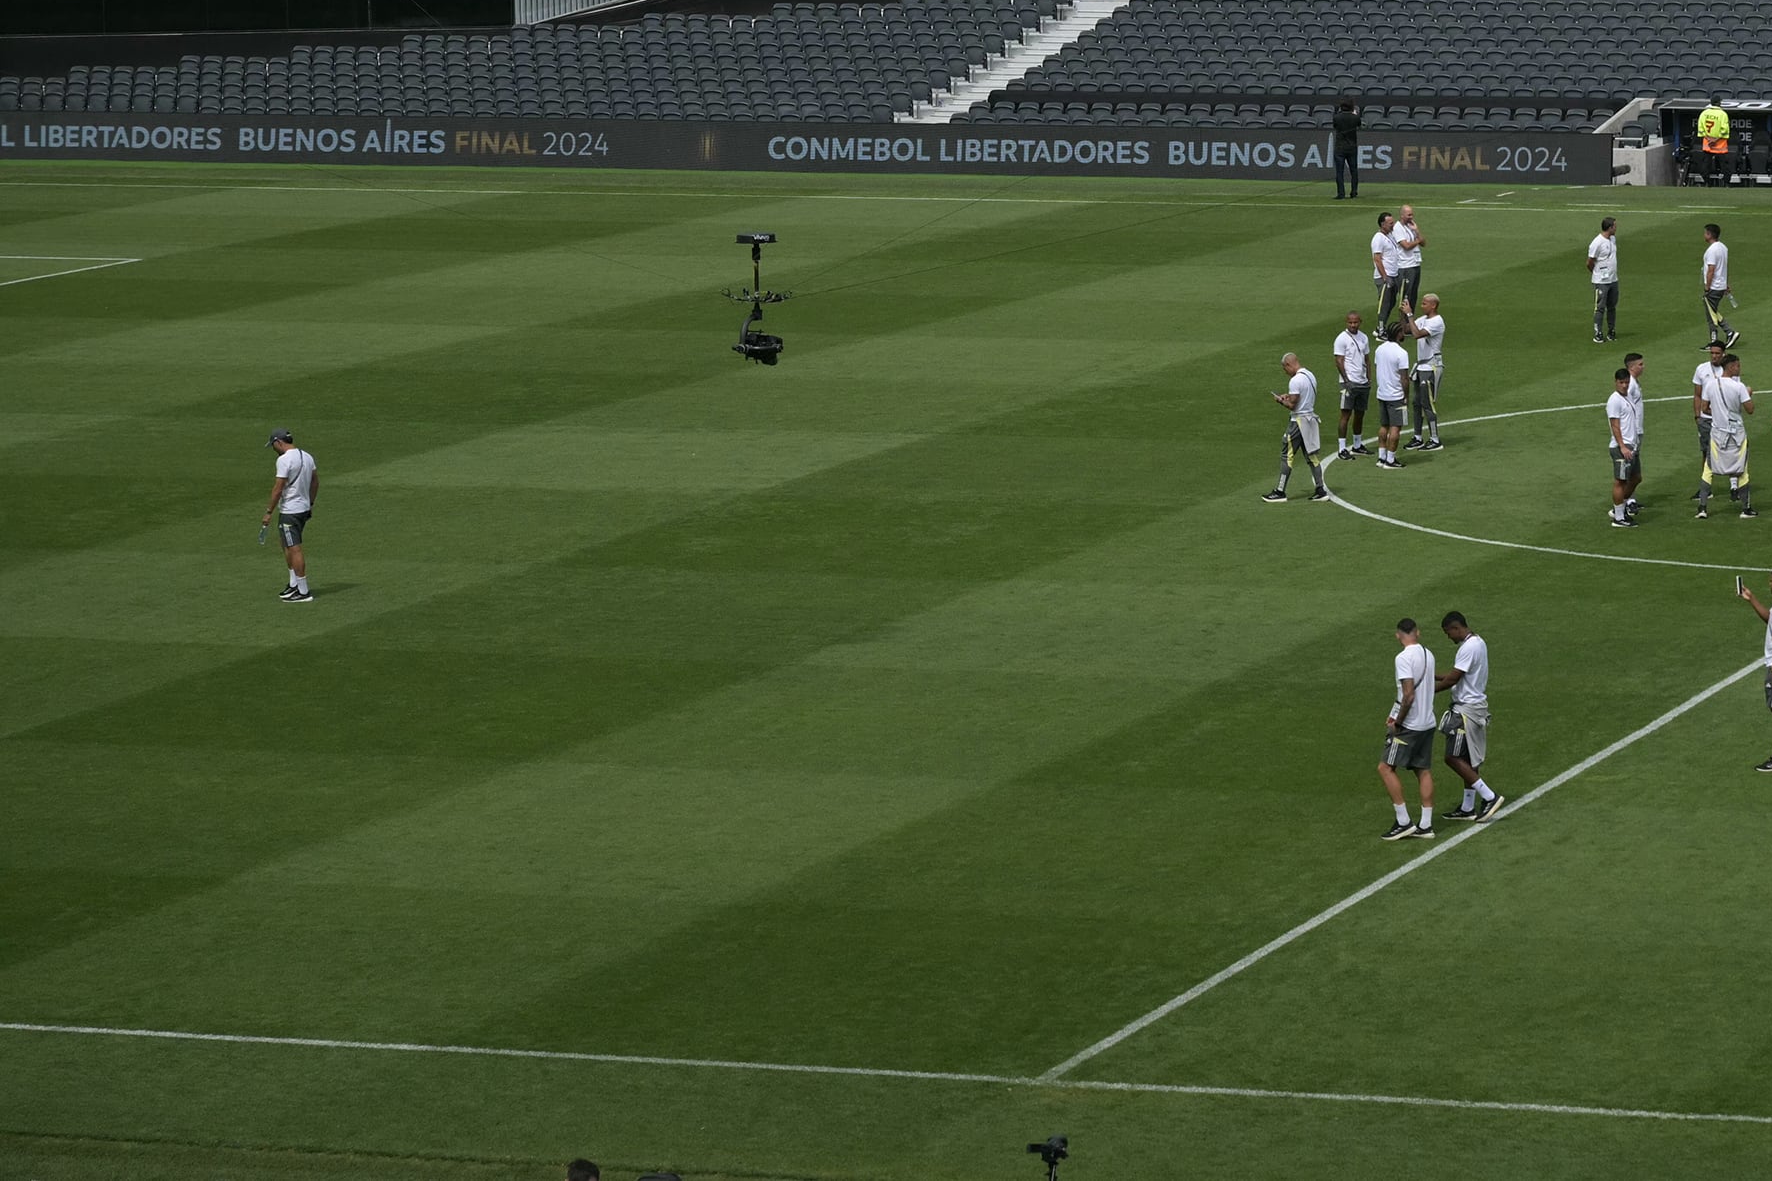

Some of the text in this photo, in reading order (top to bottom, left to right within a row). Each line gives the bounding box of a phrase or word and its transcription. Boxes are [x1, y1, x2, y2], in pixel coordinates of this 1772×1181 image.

[24, 125, 223, 150] LIBERTADORES
[238, 128, 356, 153] BUENOS
[362, 118, 446, 154] AIRES
[455, 131, 536, 155] FINAL
[542, 132, 609, 156] 2024
[768, 131, 1568, 172] CONMEBOL LIBERTADORES BUENOS AIES FINAL 2024
